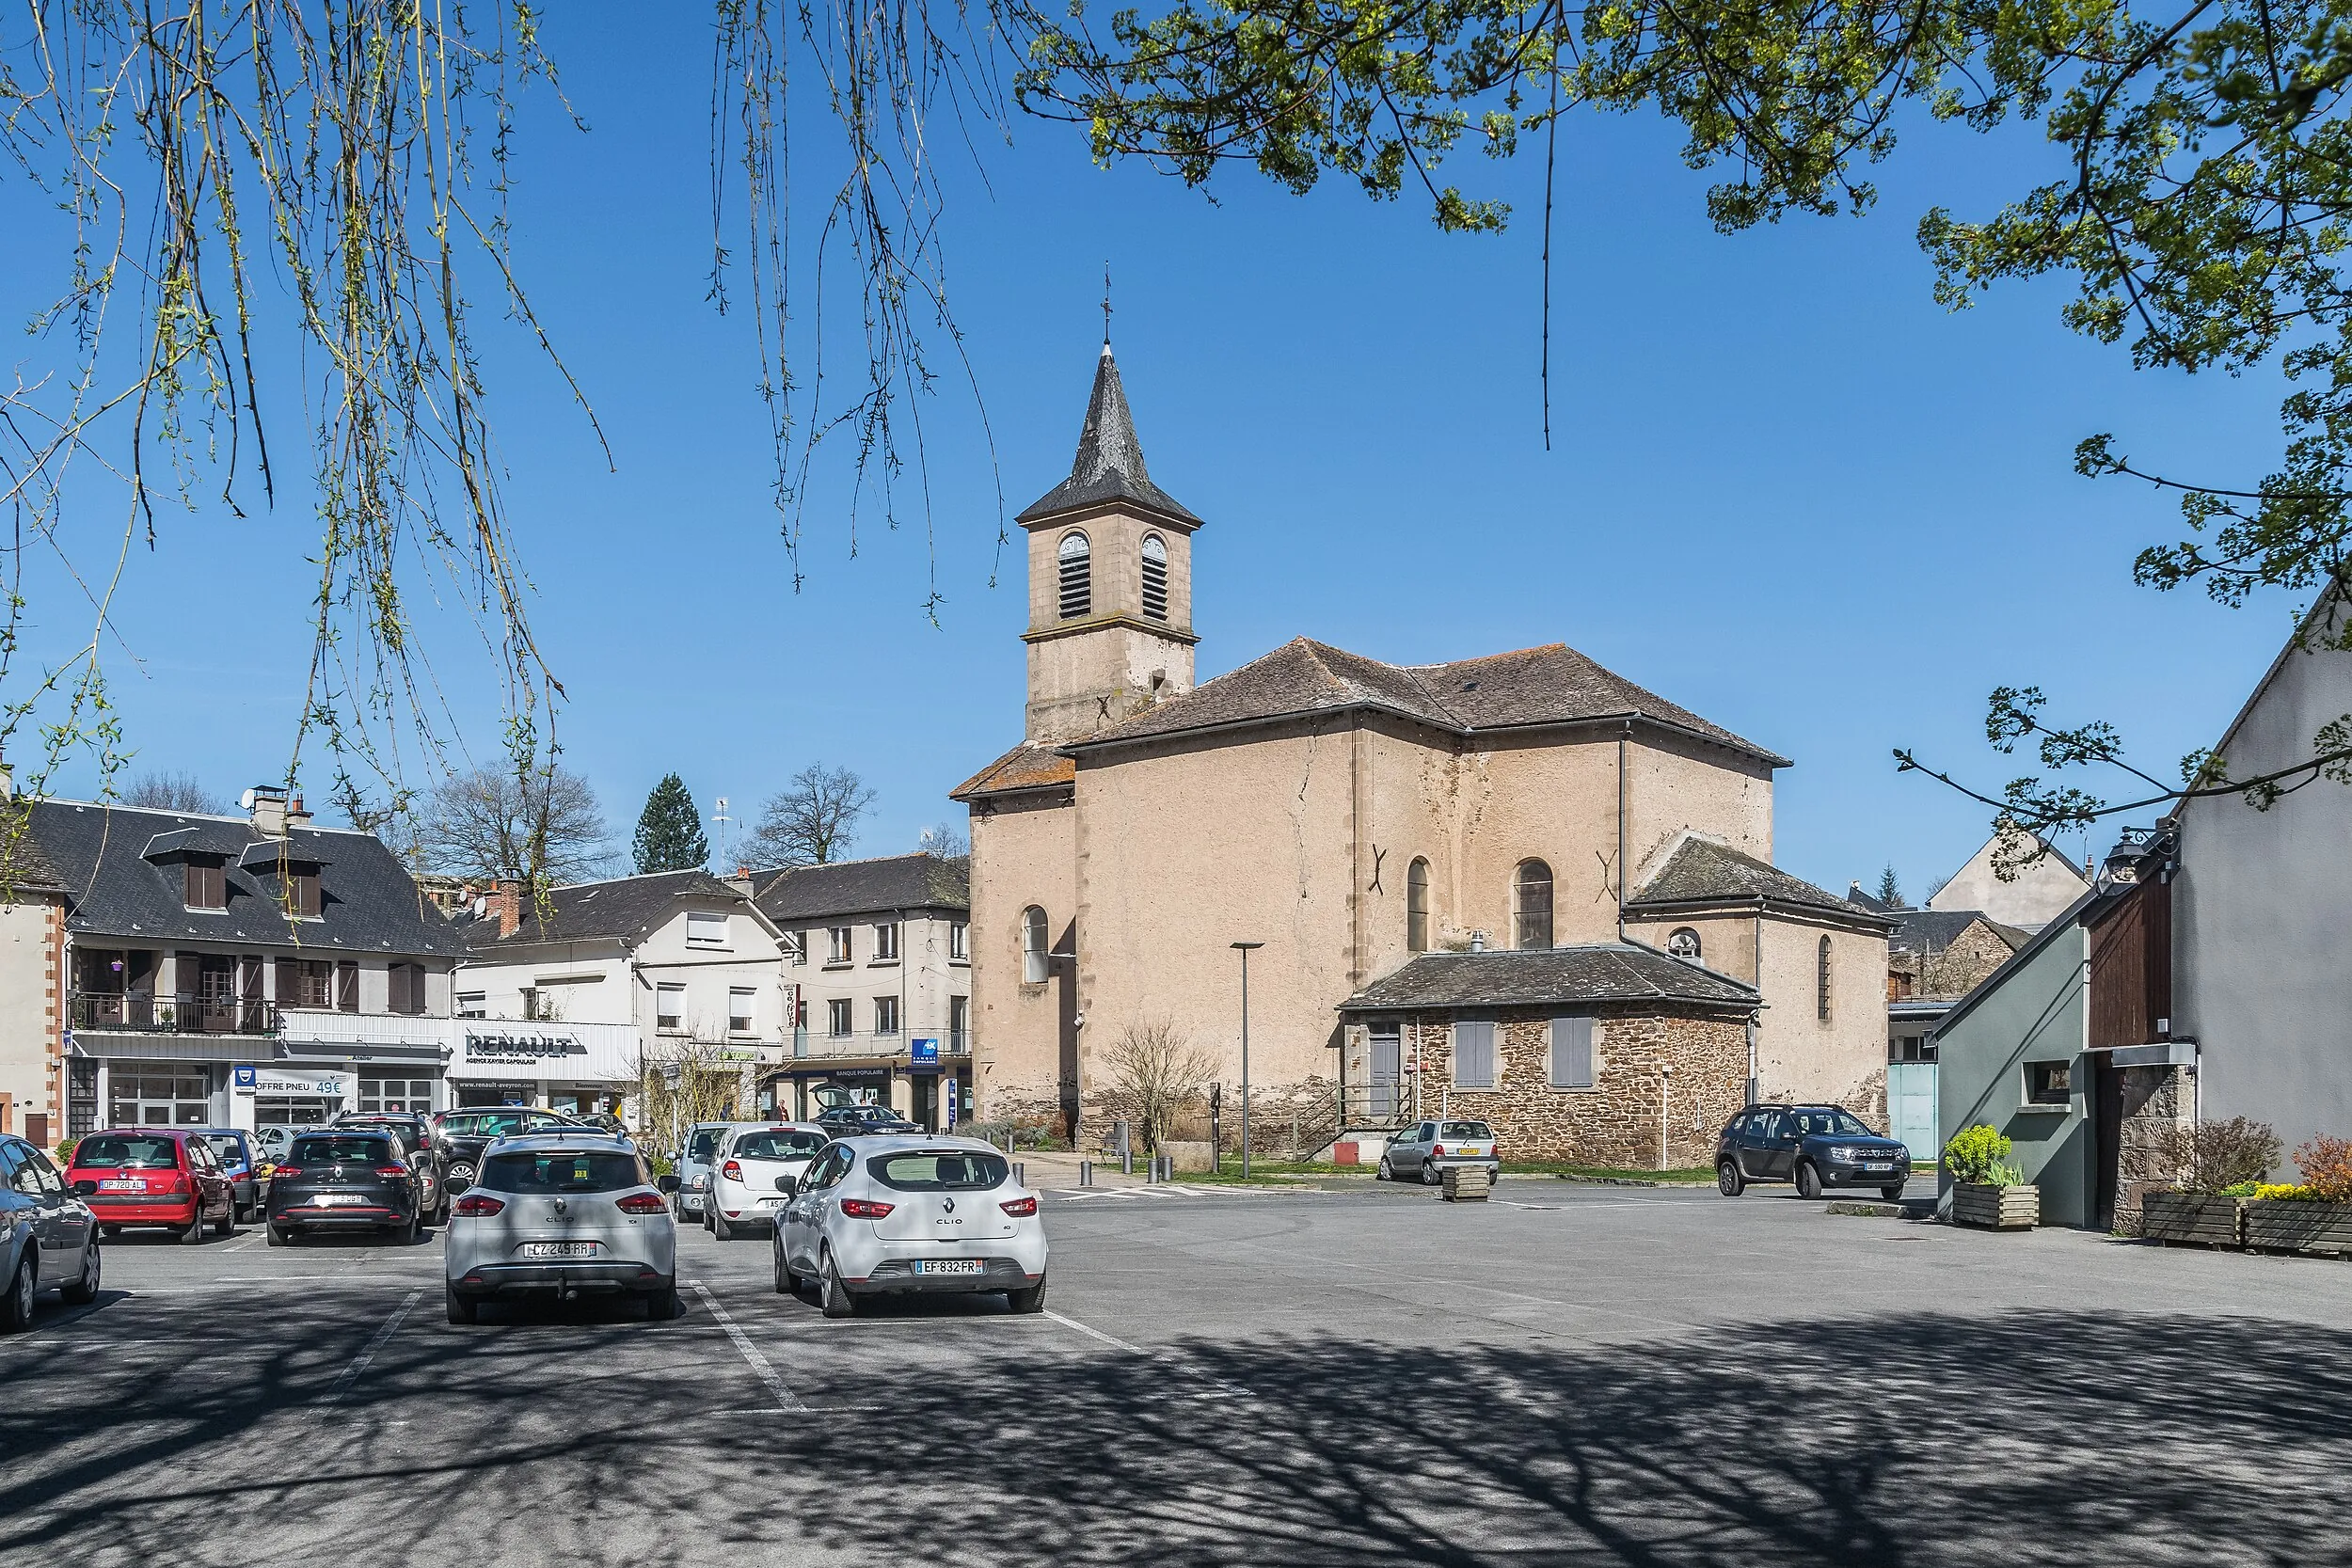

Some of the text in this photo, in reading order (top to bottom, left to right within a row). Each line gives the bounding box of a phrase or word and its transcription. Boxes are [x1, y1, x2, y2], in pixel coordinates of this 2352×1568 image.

[465, 1035, 572, 1058] RENAULT
[255, 1082, 310, 1091] OFFRE PNEU
[316, 1082, 342, 1093] 49€
[532, 1243, 588, 1256] CZ-249-RR
[924, 1261, 975, 1273] EF-832-FR
